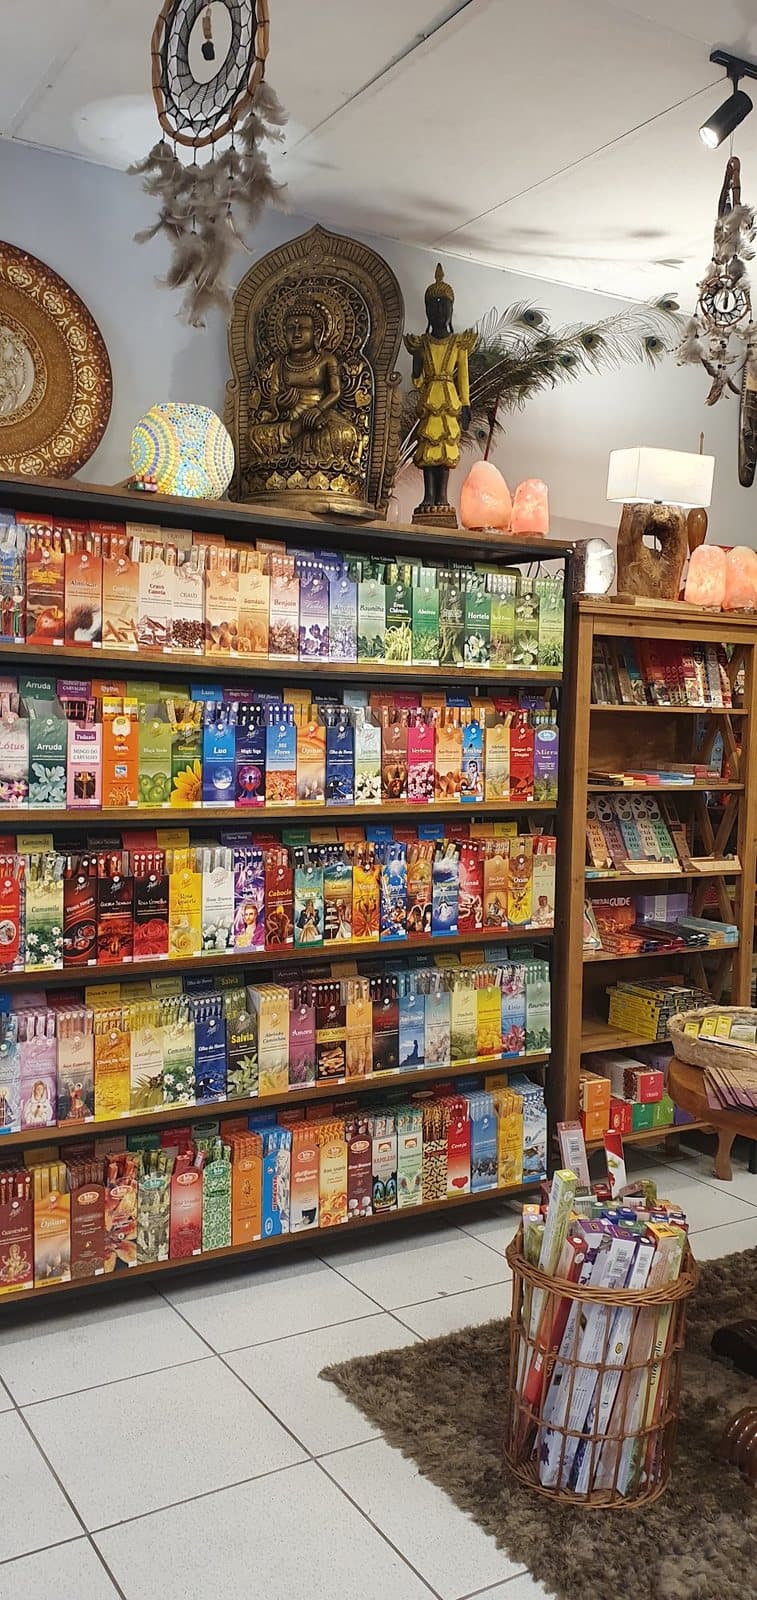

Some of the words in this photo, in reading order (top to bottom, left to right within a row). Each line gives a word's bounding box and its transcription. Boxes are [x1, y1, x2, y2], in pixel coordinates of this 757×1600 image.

[26, 681, 51, 690] Arruda
[36, 742, 63, 752] Arruda
[610, 896, 632, 906] GUIDE
[231, 1032, 254, 1044] Salvia
[650, 1340, 664, 1386] Citroella
